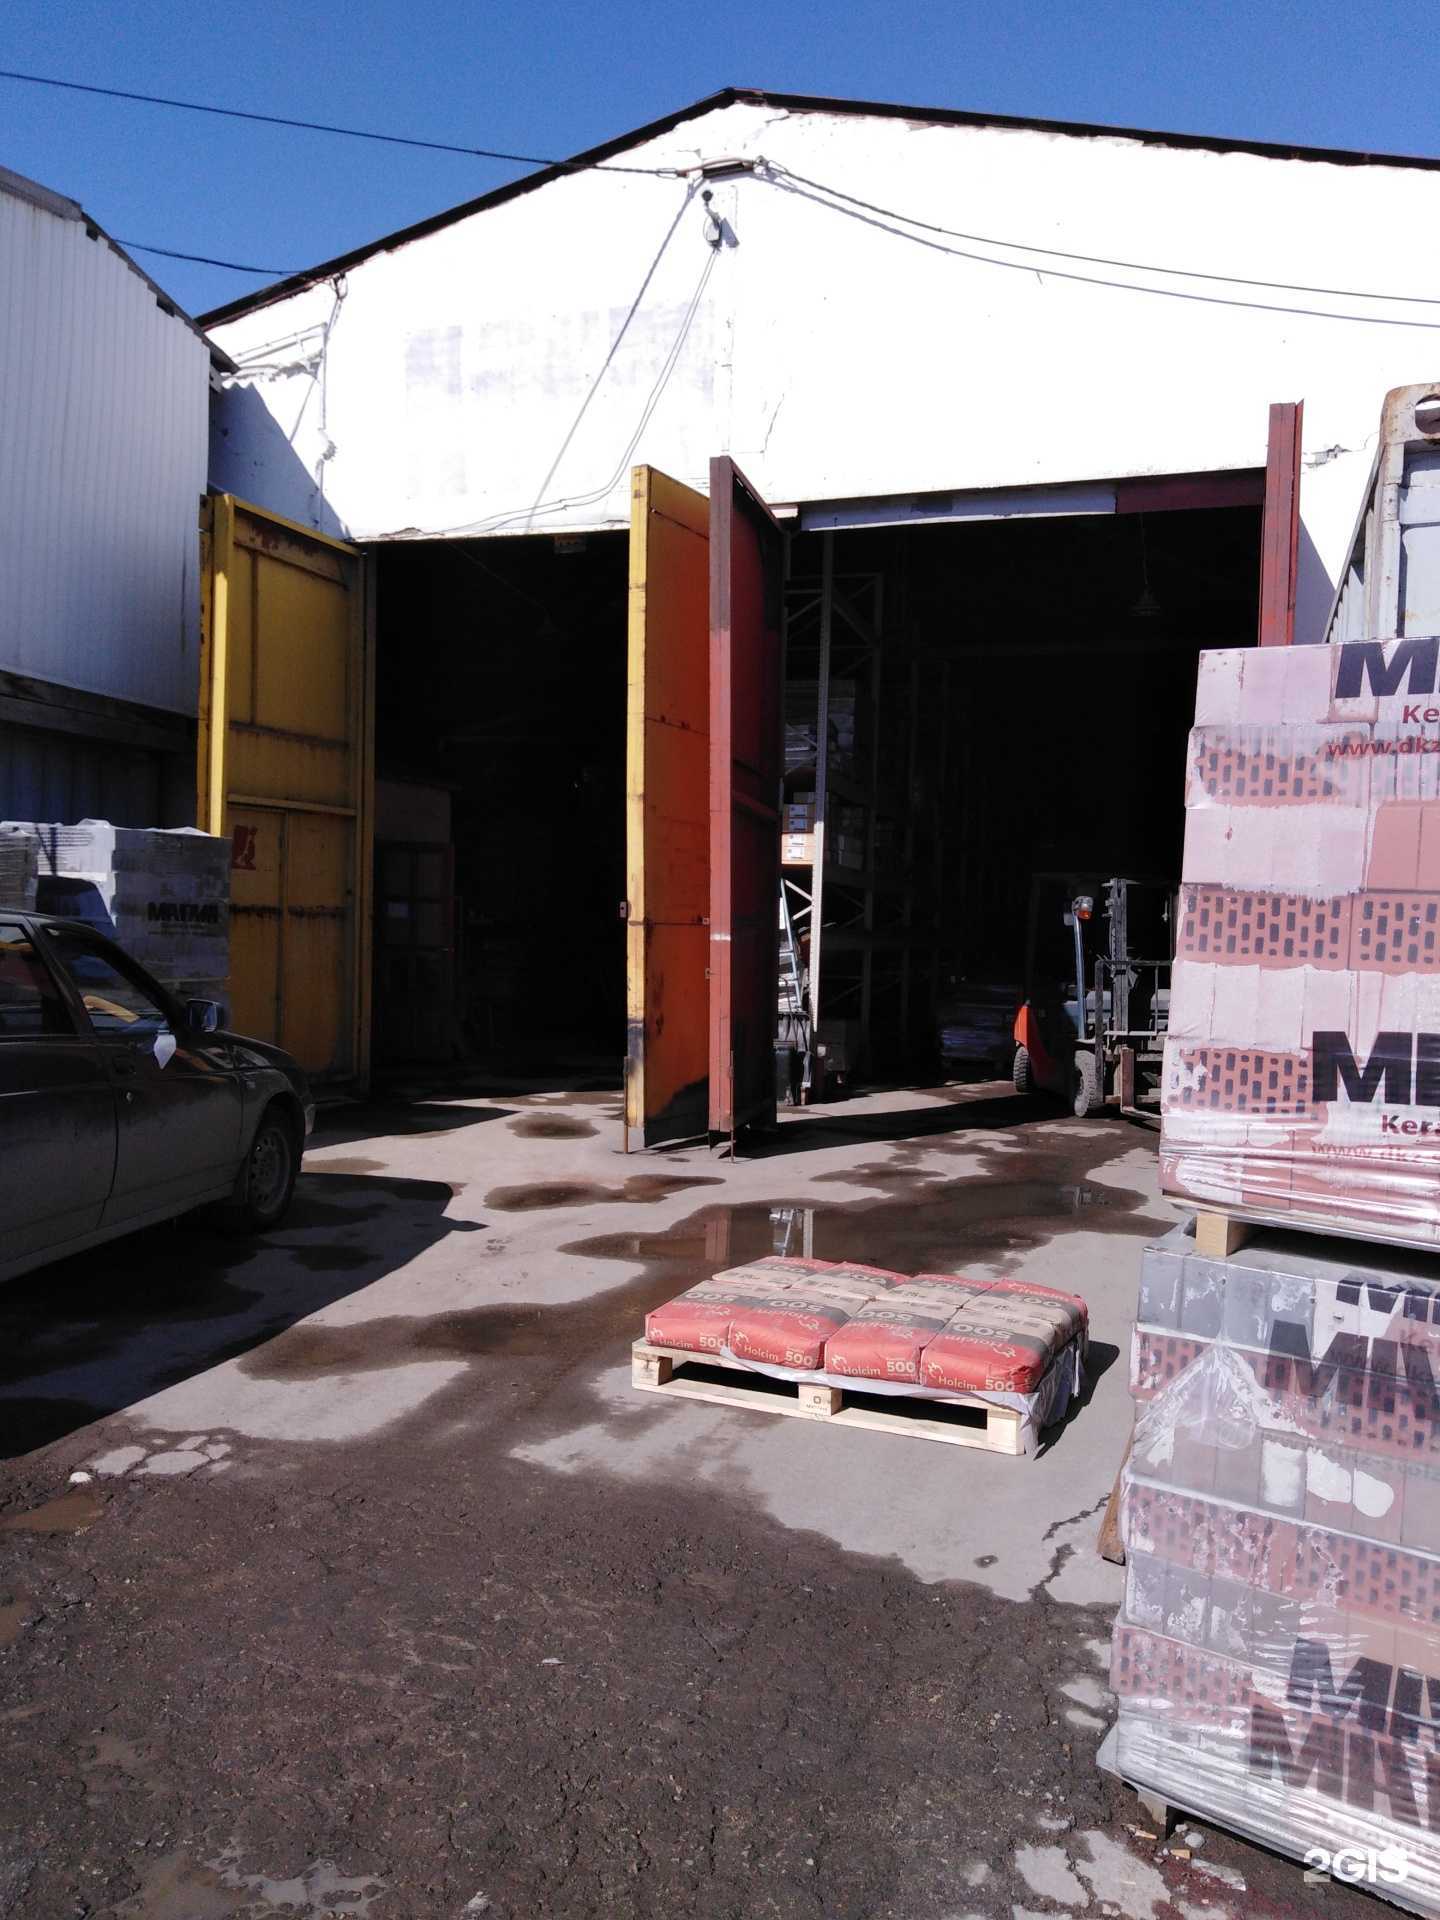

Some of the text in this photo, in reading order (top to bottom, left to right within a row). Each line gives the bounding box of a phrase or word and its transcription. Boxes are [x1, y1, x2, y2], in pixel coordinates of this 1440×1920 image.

[769, 1300, 825, 1312] 500
[857, 1310, 915, 1322] 500
[952, 1324, 1016, 1340] 500
[699, 1335, 727, 1349] 500
[743, 1343, 814, 1367] Holcim 500
[842, 1360, 916, 1376] Holcim 500
[938, 1375, 1016, 1392] Holcim 500
